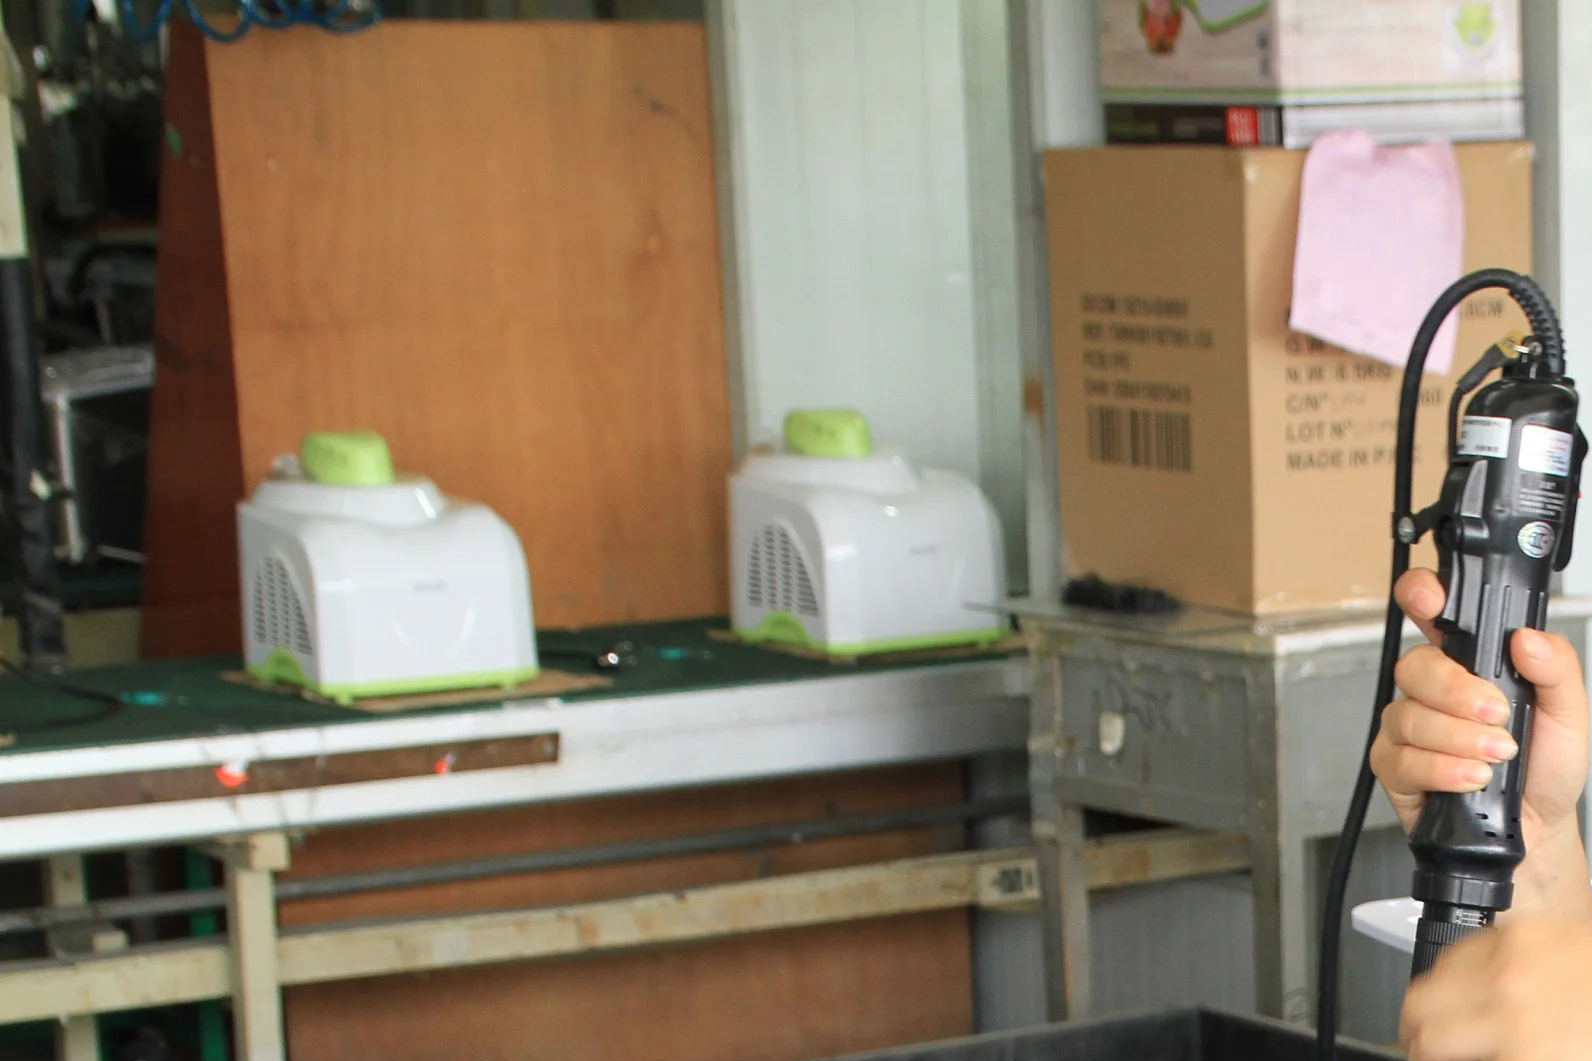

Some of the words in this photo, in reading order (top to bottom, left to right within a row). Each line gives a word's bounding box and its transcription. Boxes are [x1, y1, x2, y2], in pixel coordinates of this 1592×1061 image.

[1286, 419, 1324, 444] LOT
[1287, 450, 1344, 471] MADE
[1348, 448, 1369, 466] IN
